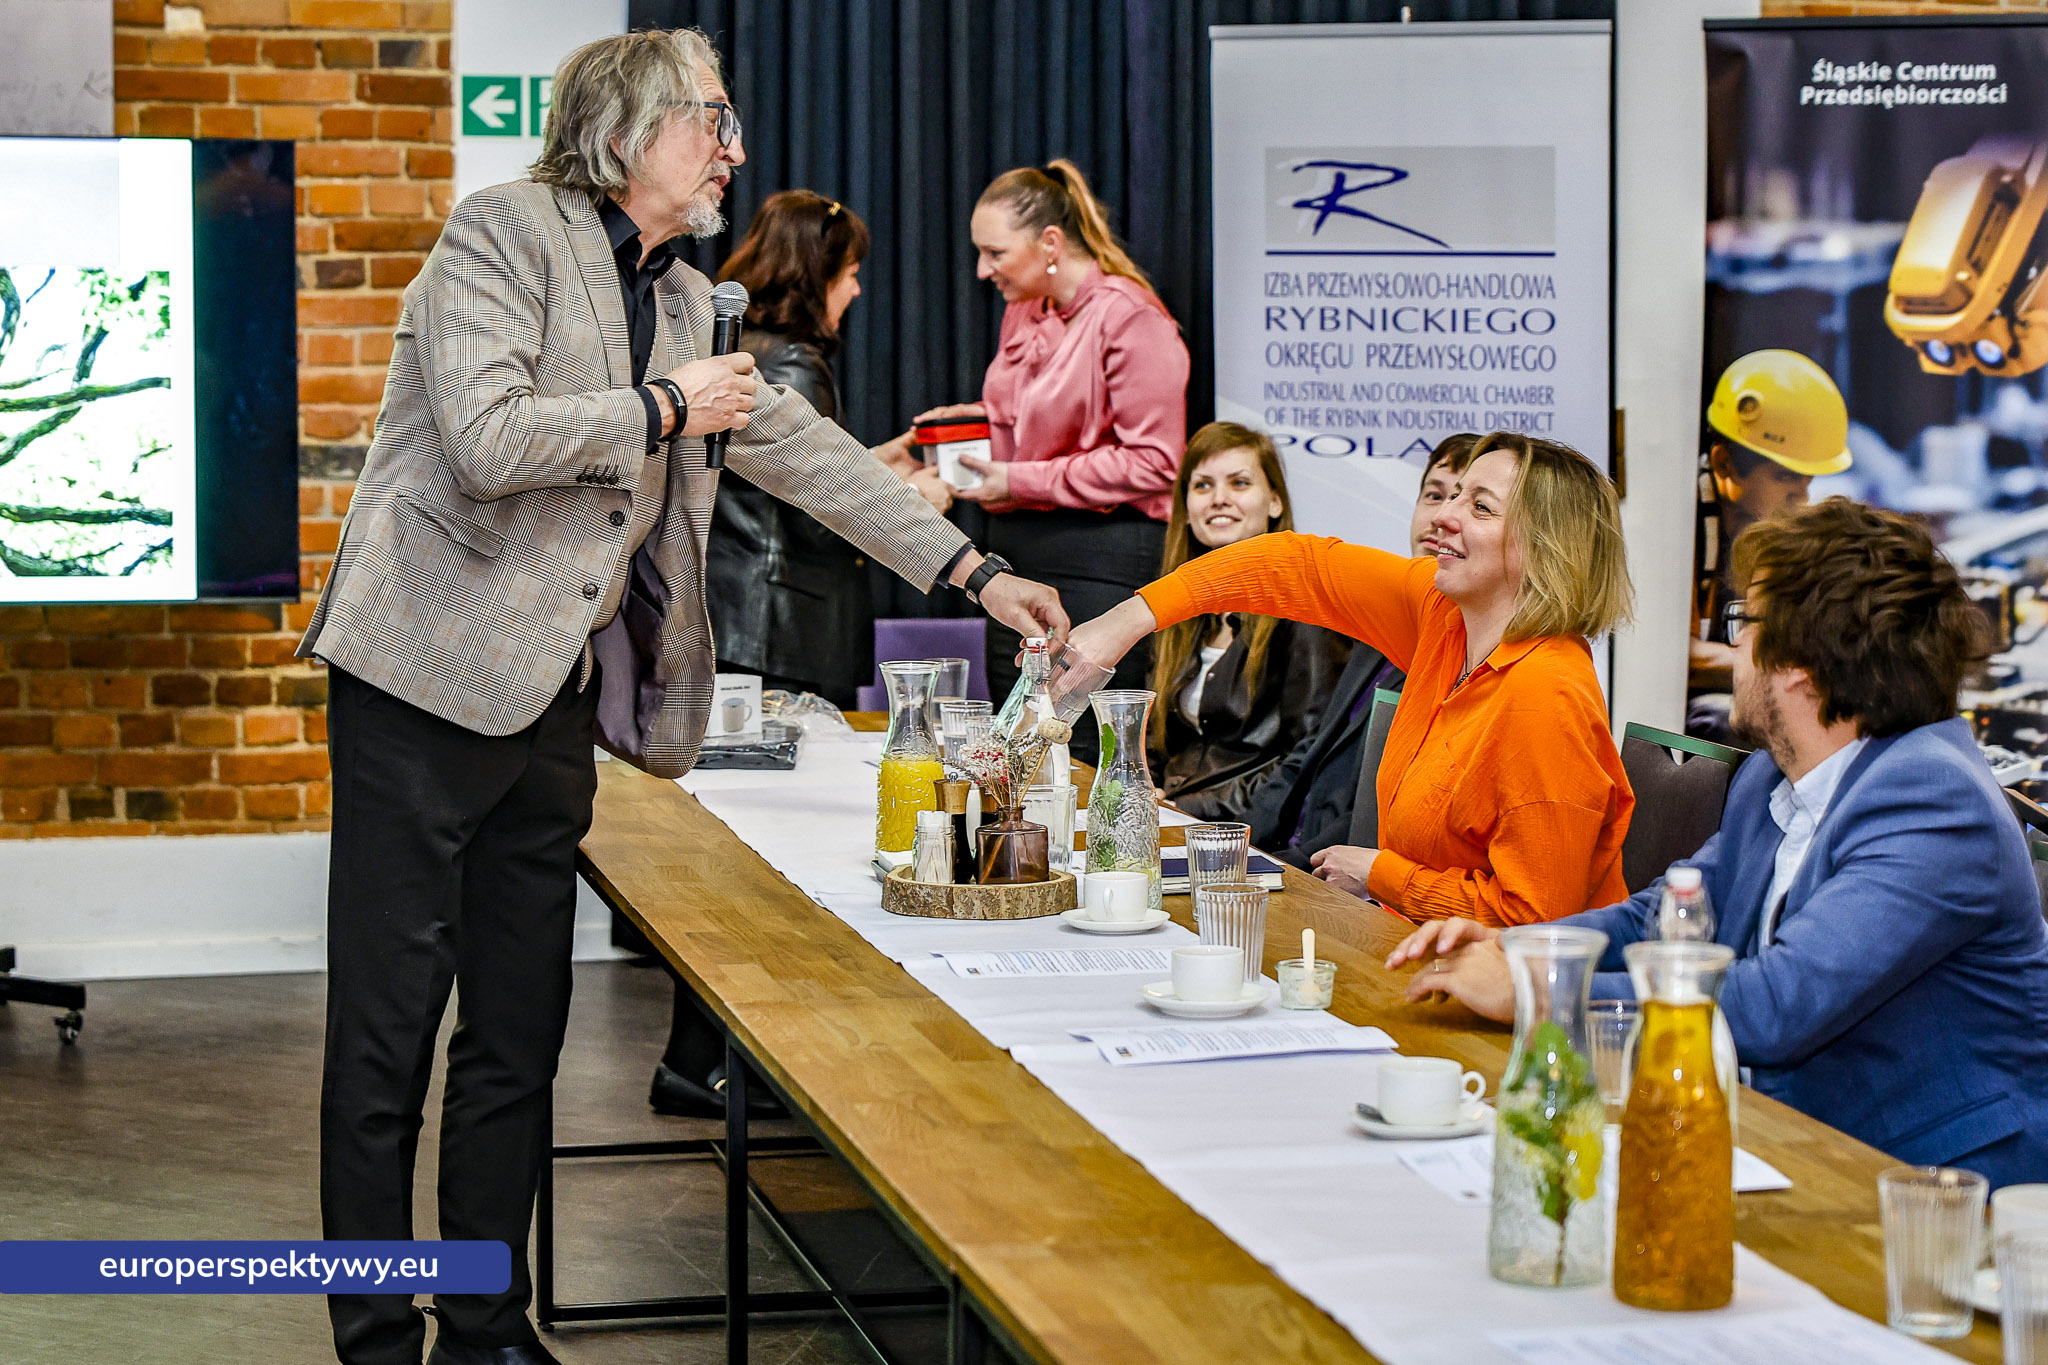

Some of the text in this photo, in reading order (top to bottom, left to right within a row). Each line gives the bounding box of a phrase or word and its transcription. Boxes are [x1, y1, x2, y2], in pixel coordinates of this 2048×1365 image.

[1812, 58, 1997, 86] Śląskie Centrum
[1800, 83, 2008, 109] Przedsiębiorczości
[1264, 271, 1556, 299] IZBA PRZEMYSŁOWO-HANDLOWA
[1265, 305, 1556, 335] RYBNICKIEGO
[1265, 340, 1556, 374] OKRĘGU PRZEMYSŁOWEGO
[1264, 381, 1555, 407] INDUSTRIAL AND COMMERCIAL CHAMBER
[1264, 406, 1555, 433] OF THE RYBNIK INDUSTRIAL DISTRICT
[1271, 433, 1434, 458] POLA
